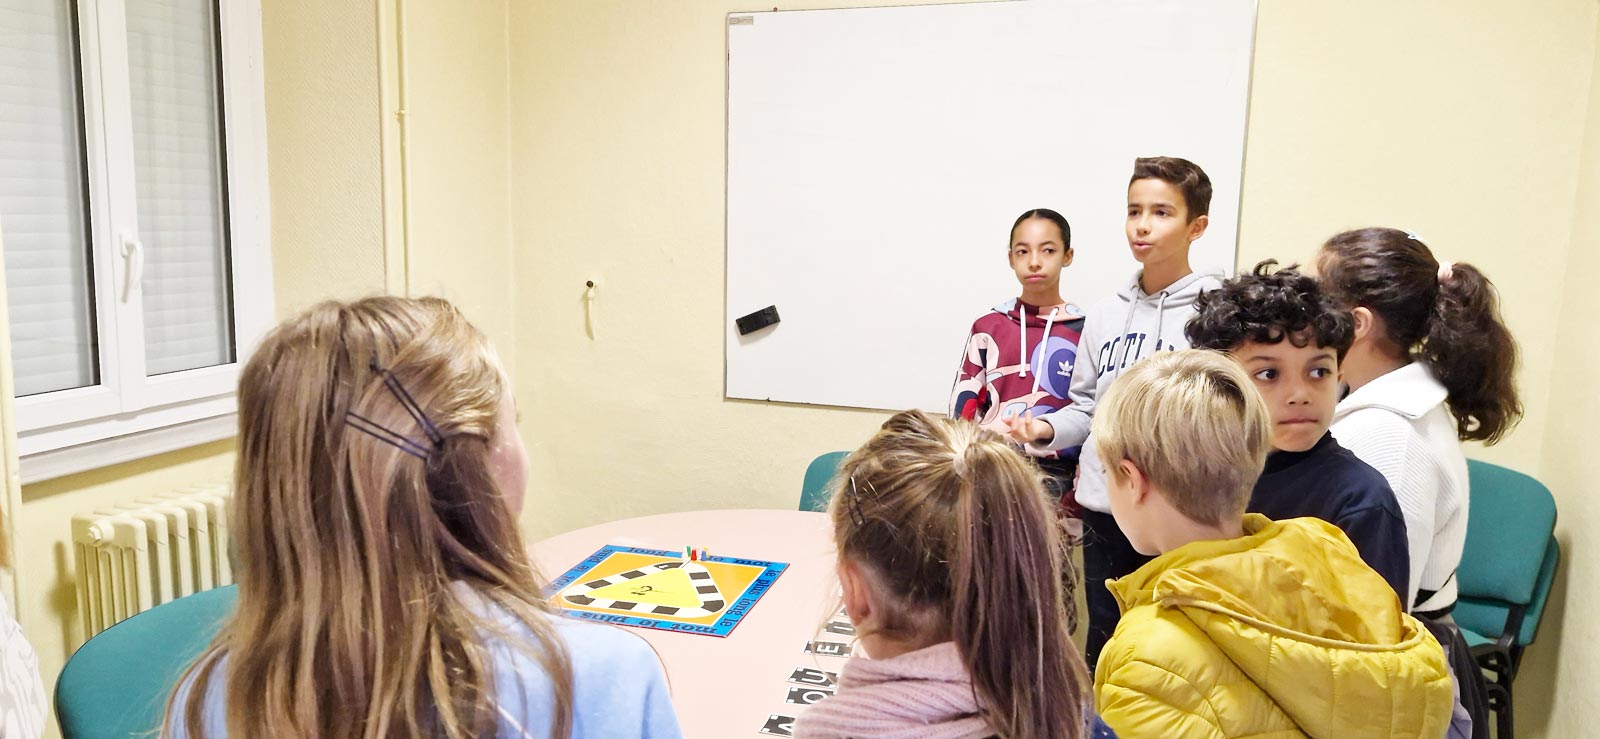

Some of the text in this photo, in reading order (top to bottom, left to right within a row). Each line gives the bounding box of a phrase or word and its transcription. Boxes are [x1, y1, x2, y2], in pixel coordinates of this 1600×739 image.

[732, 558, 772, 567] mot
[720, 569, 782, 627] le plus long le
[579, 611, 718, 634] mot le plus
